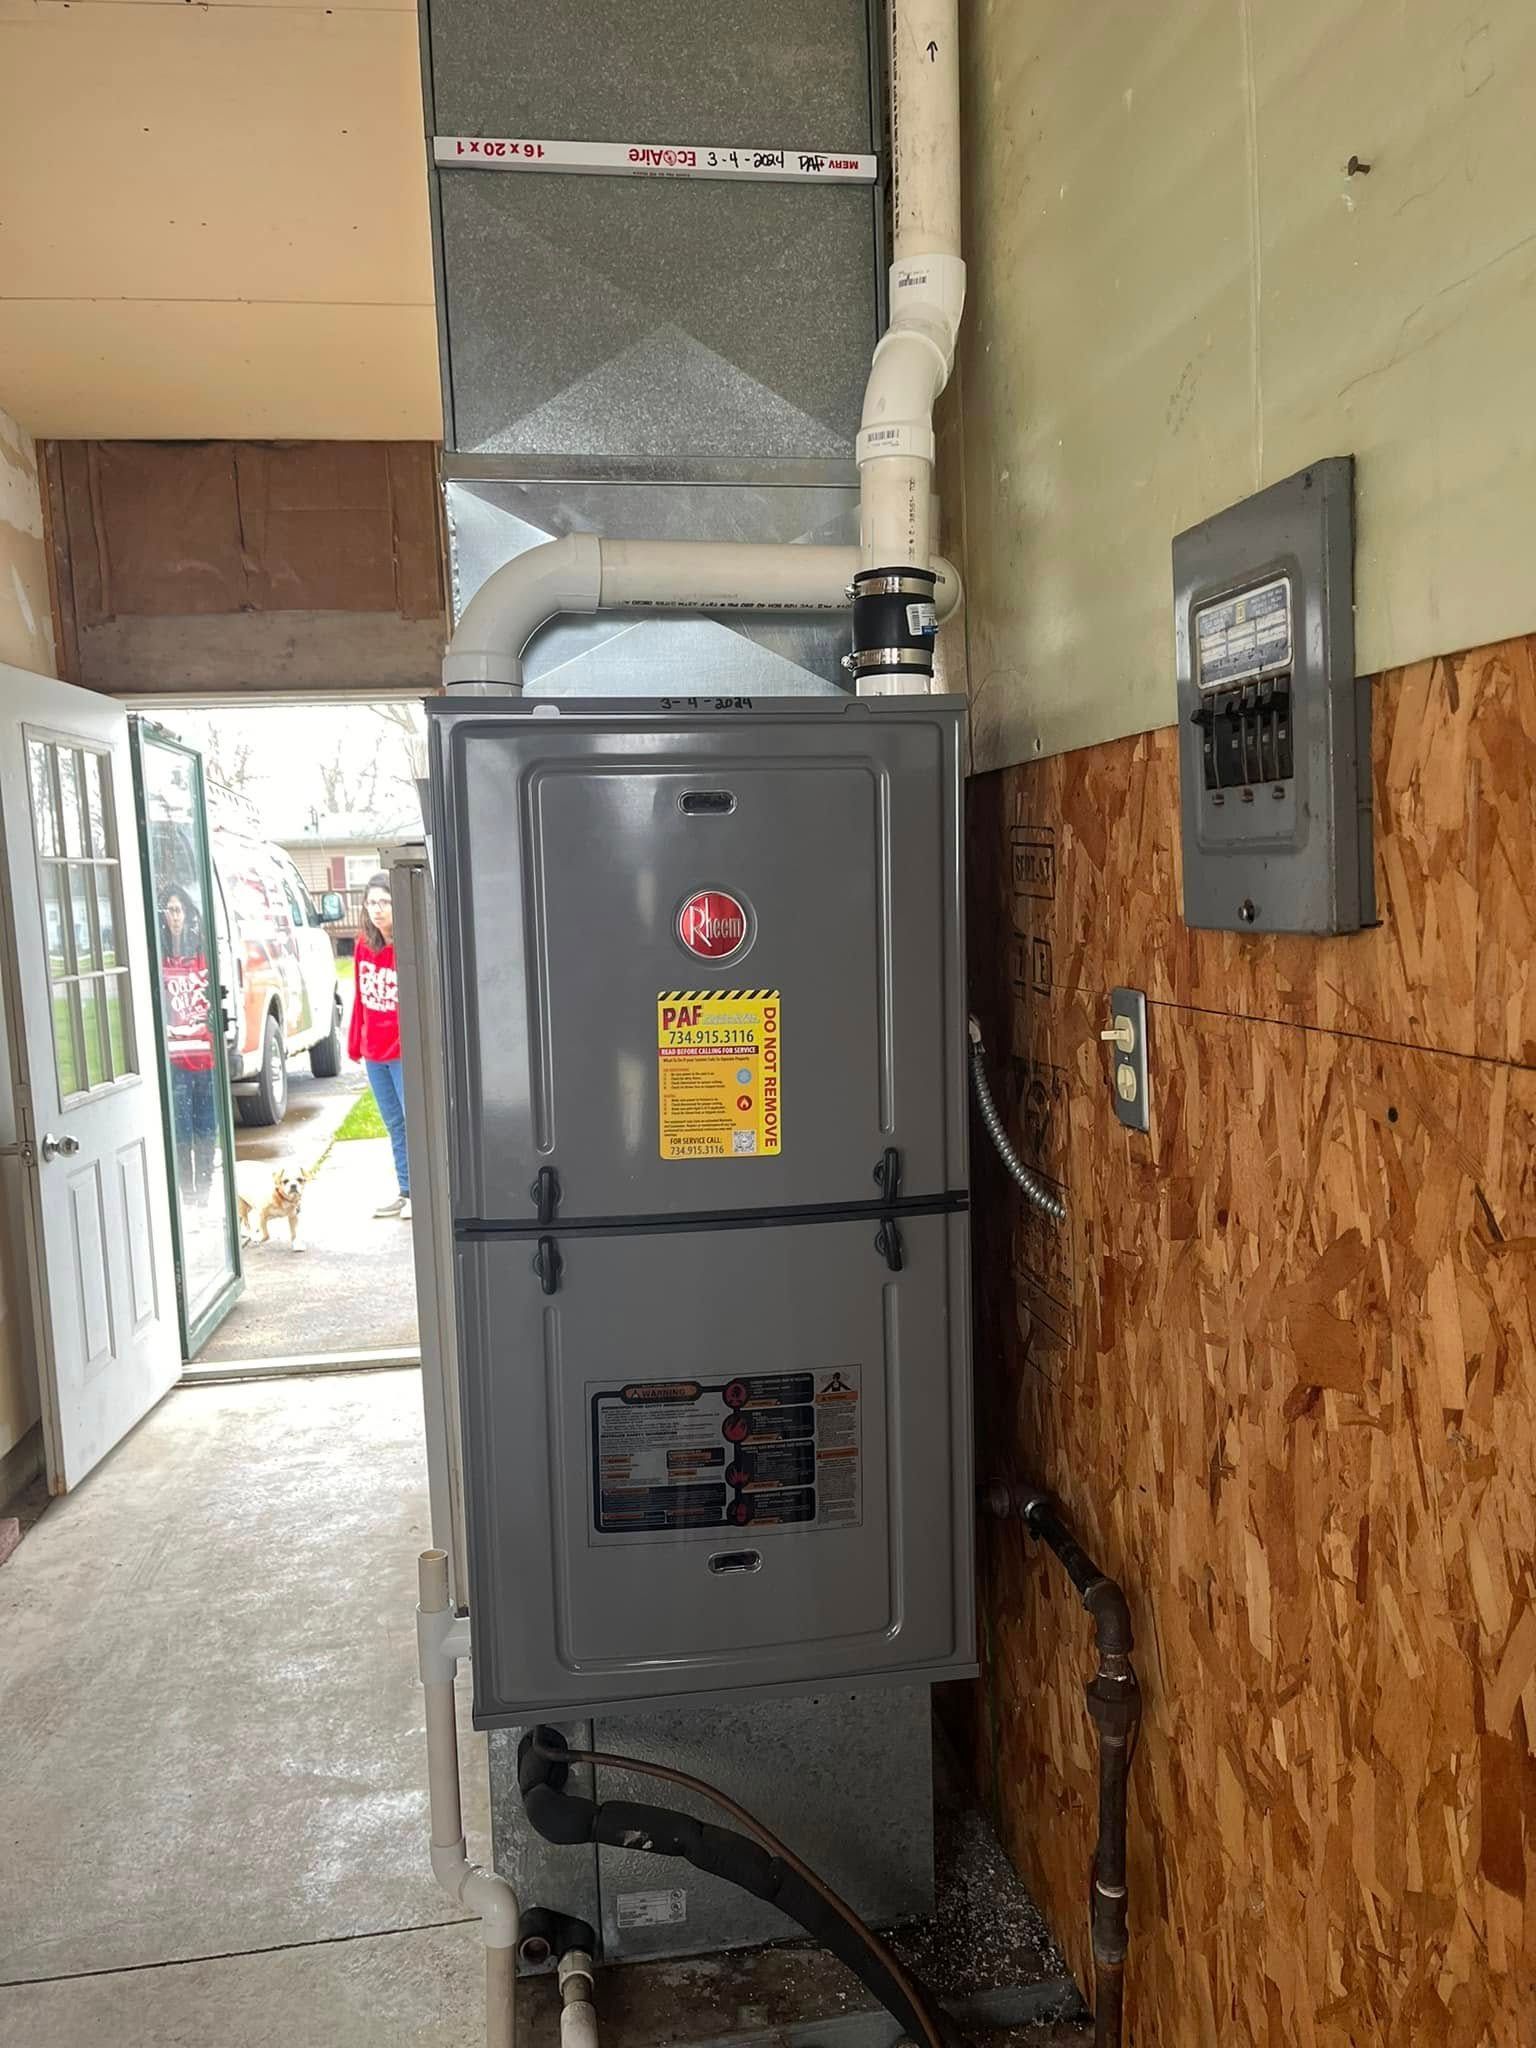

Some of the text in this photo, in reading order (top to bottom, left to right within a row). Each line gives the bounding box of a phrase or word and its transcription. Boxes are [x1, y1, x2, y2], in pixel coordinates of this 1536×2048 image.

[456, 141, 545, 158] 16 x 20 x 1
[798, 154, 829, 172] PAF
[827, 159, 860, 170] MERV
[688, 896, 742, 948] Rheem
[662, 1004, 703, 1031] PAF
[669, 1029, 754, 1045] 734.915.3116
[661, 1045, 757, 1056] READ BEFORE CALLING FOR SERVICE
[763, 1006, 778, 1148] DO NOT REMOVE
[670, 1137, 681, 1145] FOR
[670, 1145, 725, 1155] 734.915.3116
[641, 1388, 686, 1398] WARNING
